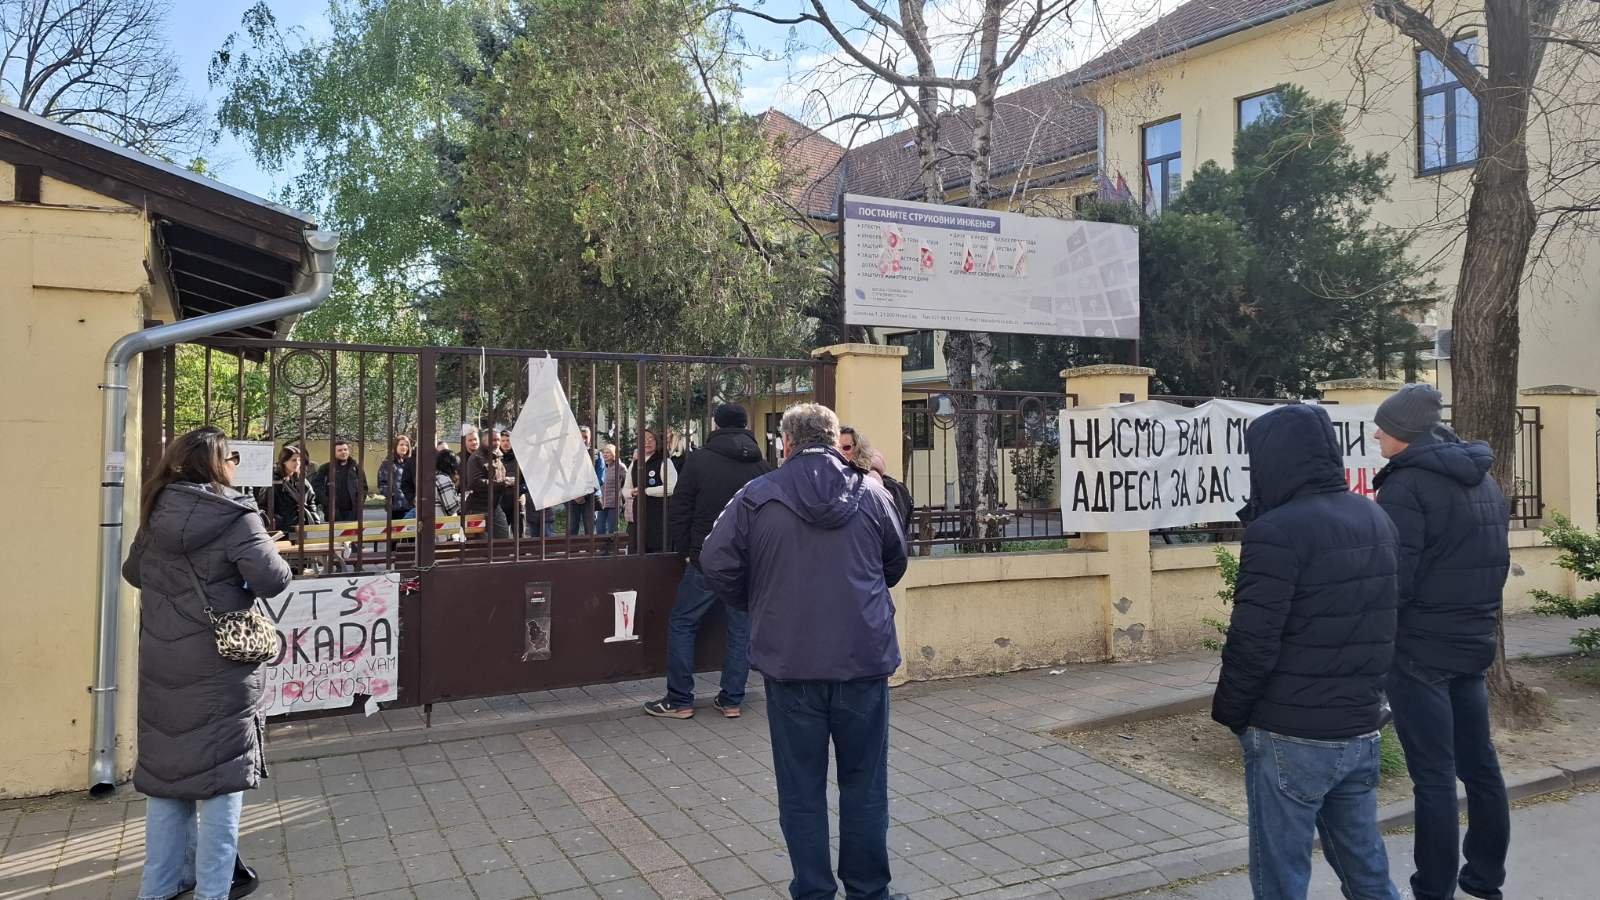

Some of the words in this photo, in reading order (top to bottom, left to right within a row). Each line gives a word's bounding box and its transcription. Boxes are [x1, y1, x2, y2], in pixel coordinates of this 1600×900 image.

[858, 207, 908, 220] ПОСТАНИТЕ
[909, 212, 956, 225] СТРУКОВНИ
[957, 217, 997, 228] ИНЖЕЊЕР
[1069, 417, 1166, 459] НИСМО
[1174, 416, 1213, 457] ВАМ
[1072, 469, 1162, 512] АДРЕСА
[1170, 467, 1191, 507] ЗА
[1195, 466, 1235, 505] ВАС
[261, 579, 363, 624] VTŠ
[365, 656, 396, 673] VAM
